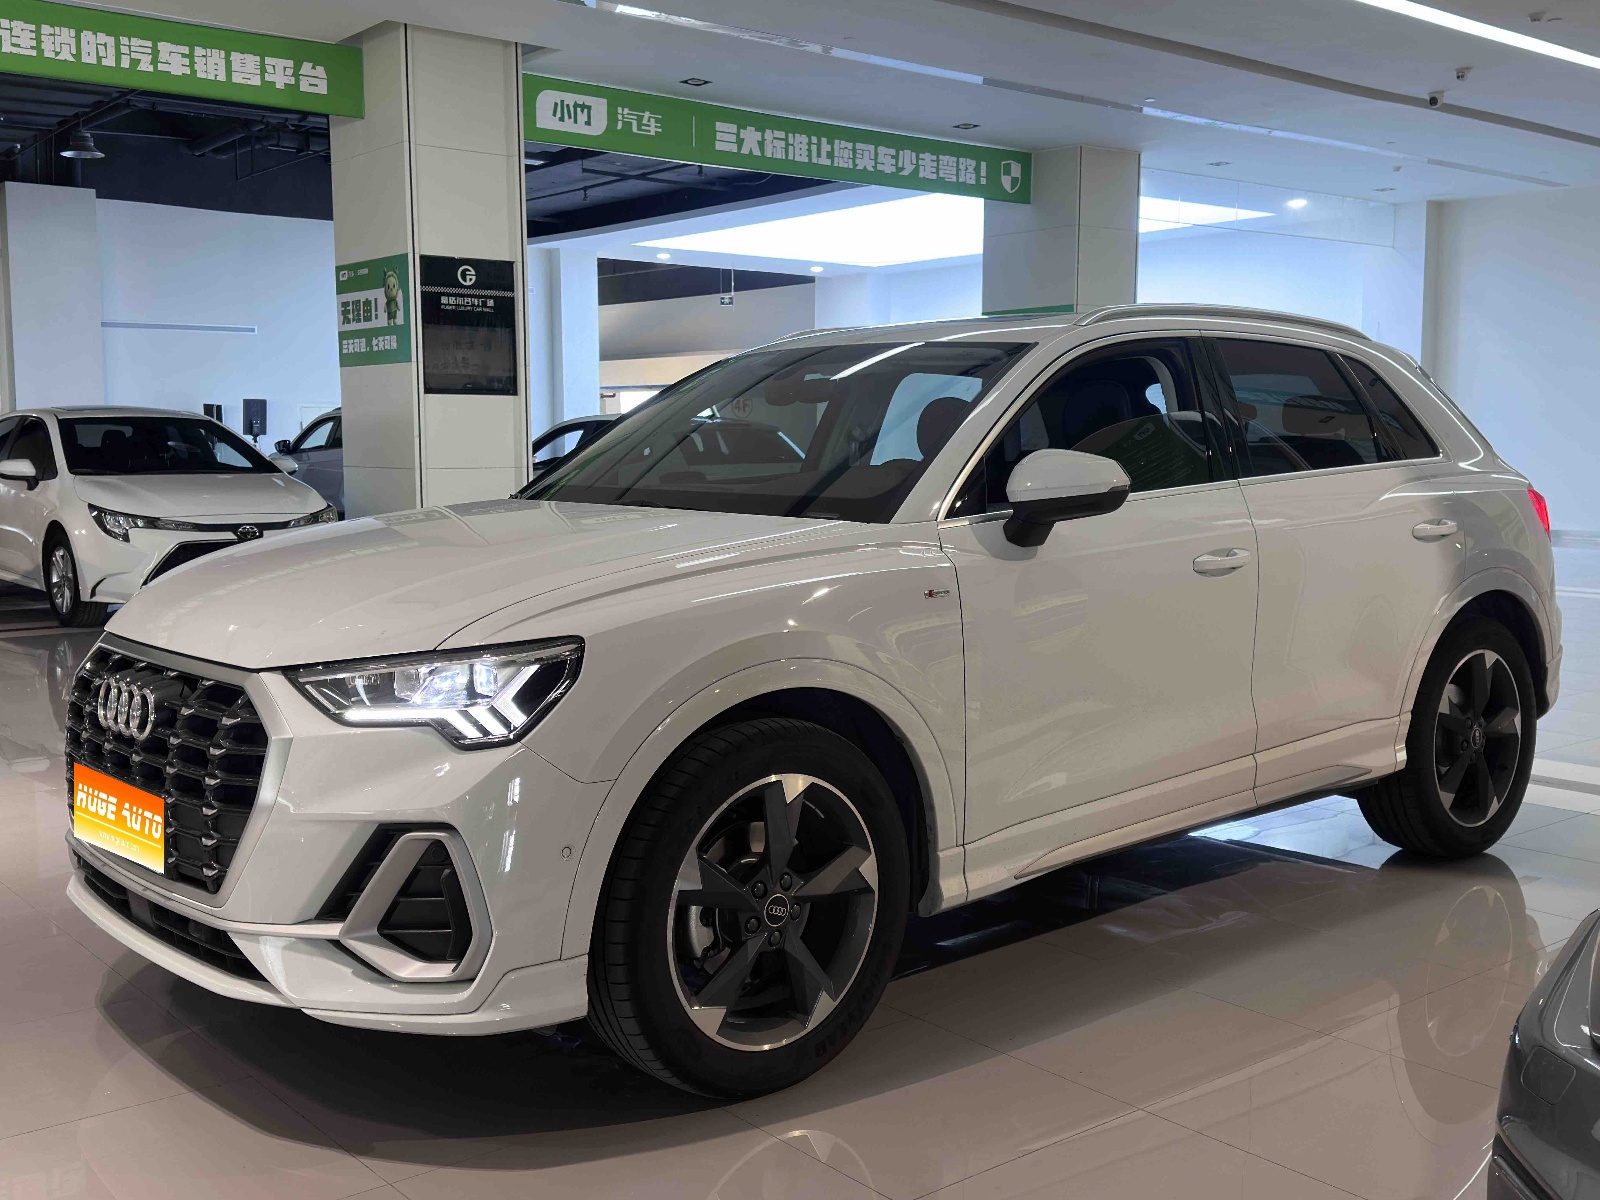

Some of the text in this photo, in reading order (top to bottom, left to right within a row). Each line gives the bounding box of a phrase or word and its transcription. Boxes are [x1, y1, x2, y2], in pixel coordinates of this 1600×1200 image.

[0, 18, 328, 95] 连锁的汽车销售平台
[552, 99, 662, 136] 小竹 汽车
[715, 121, 987, 185] 三大标准让您买车少走弯路！
[341, 297, 379, 326] 无理由！
[735, 399, 750, 412] 4F
